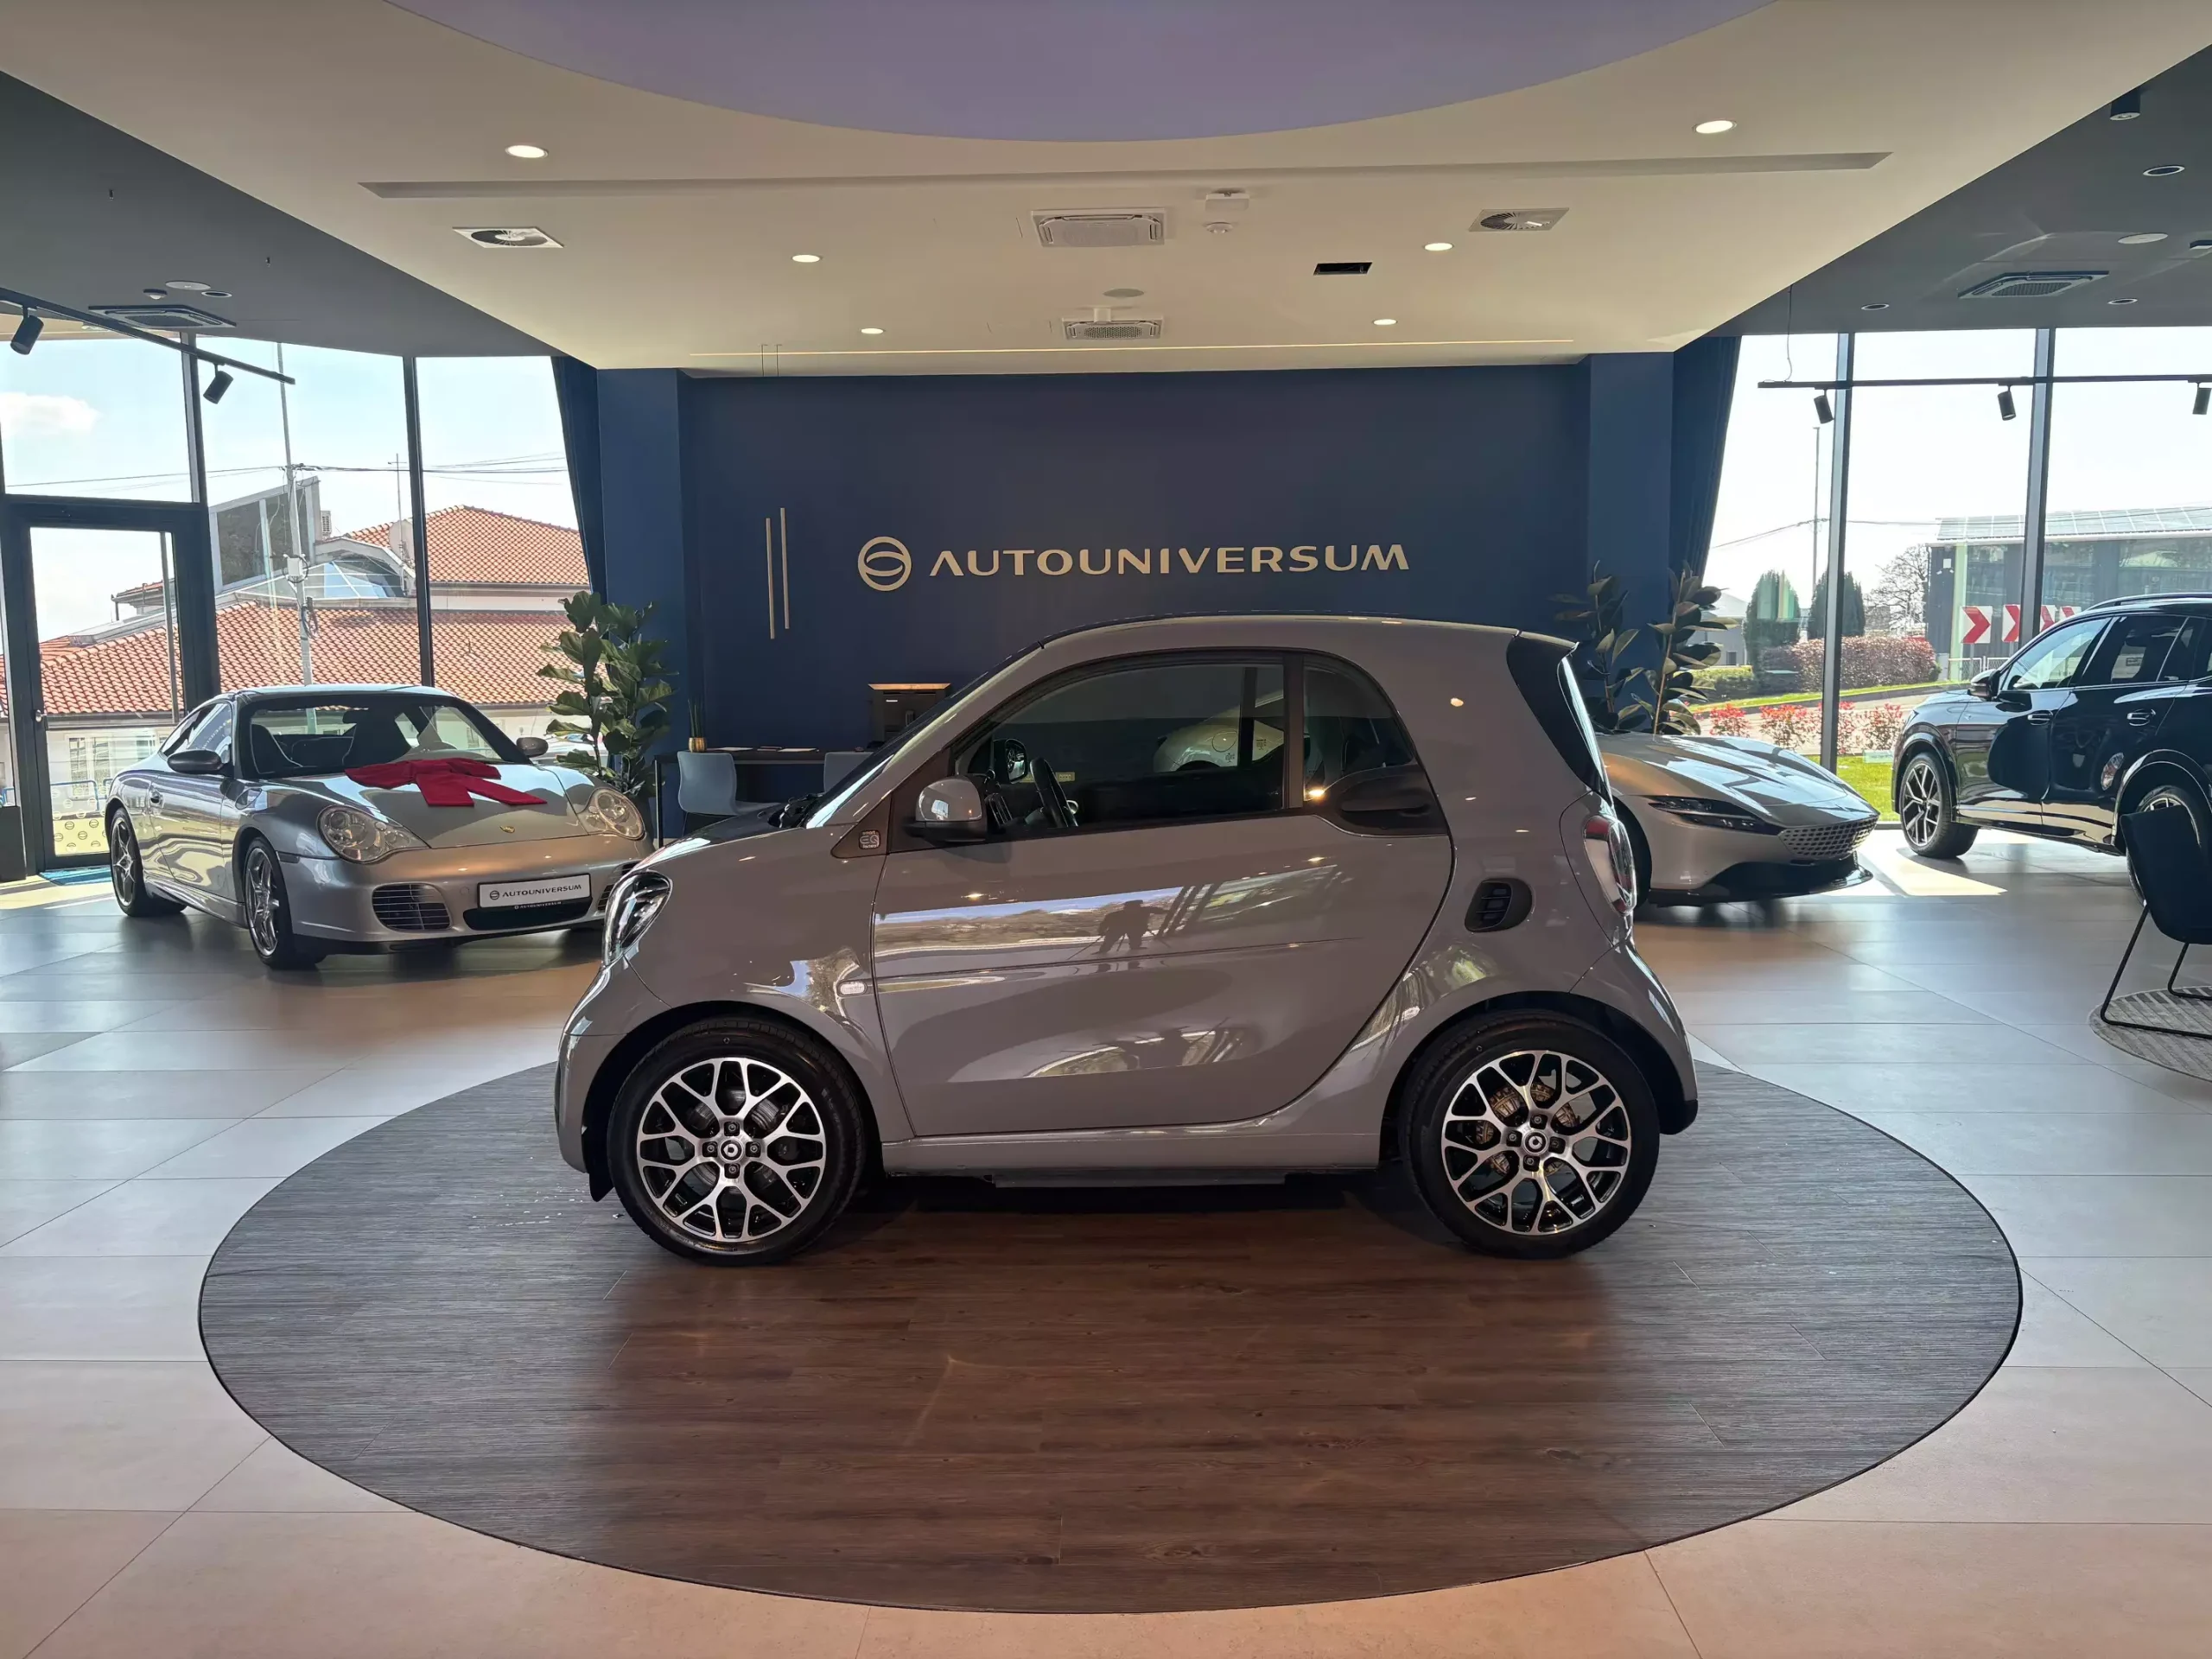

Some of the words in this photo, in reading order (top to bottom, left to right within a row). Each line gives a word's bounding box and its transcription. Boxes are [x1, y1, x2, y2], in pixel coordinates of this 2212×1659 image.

[930, 543, 1409, 575] AUTOUNIVERSUM
[860, 835, 879, 847] EQ
[502, 884, 582, 897] AUTOUNIVERSUM
